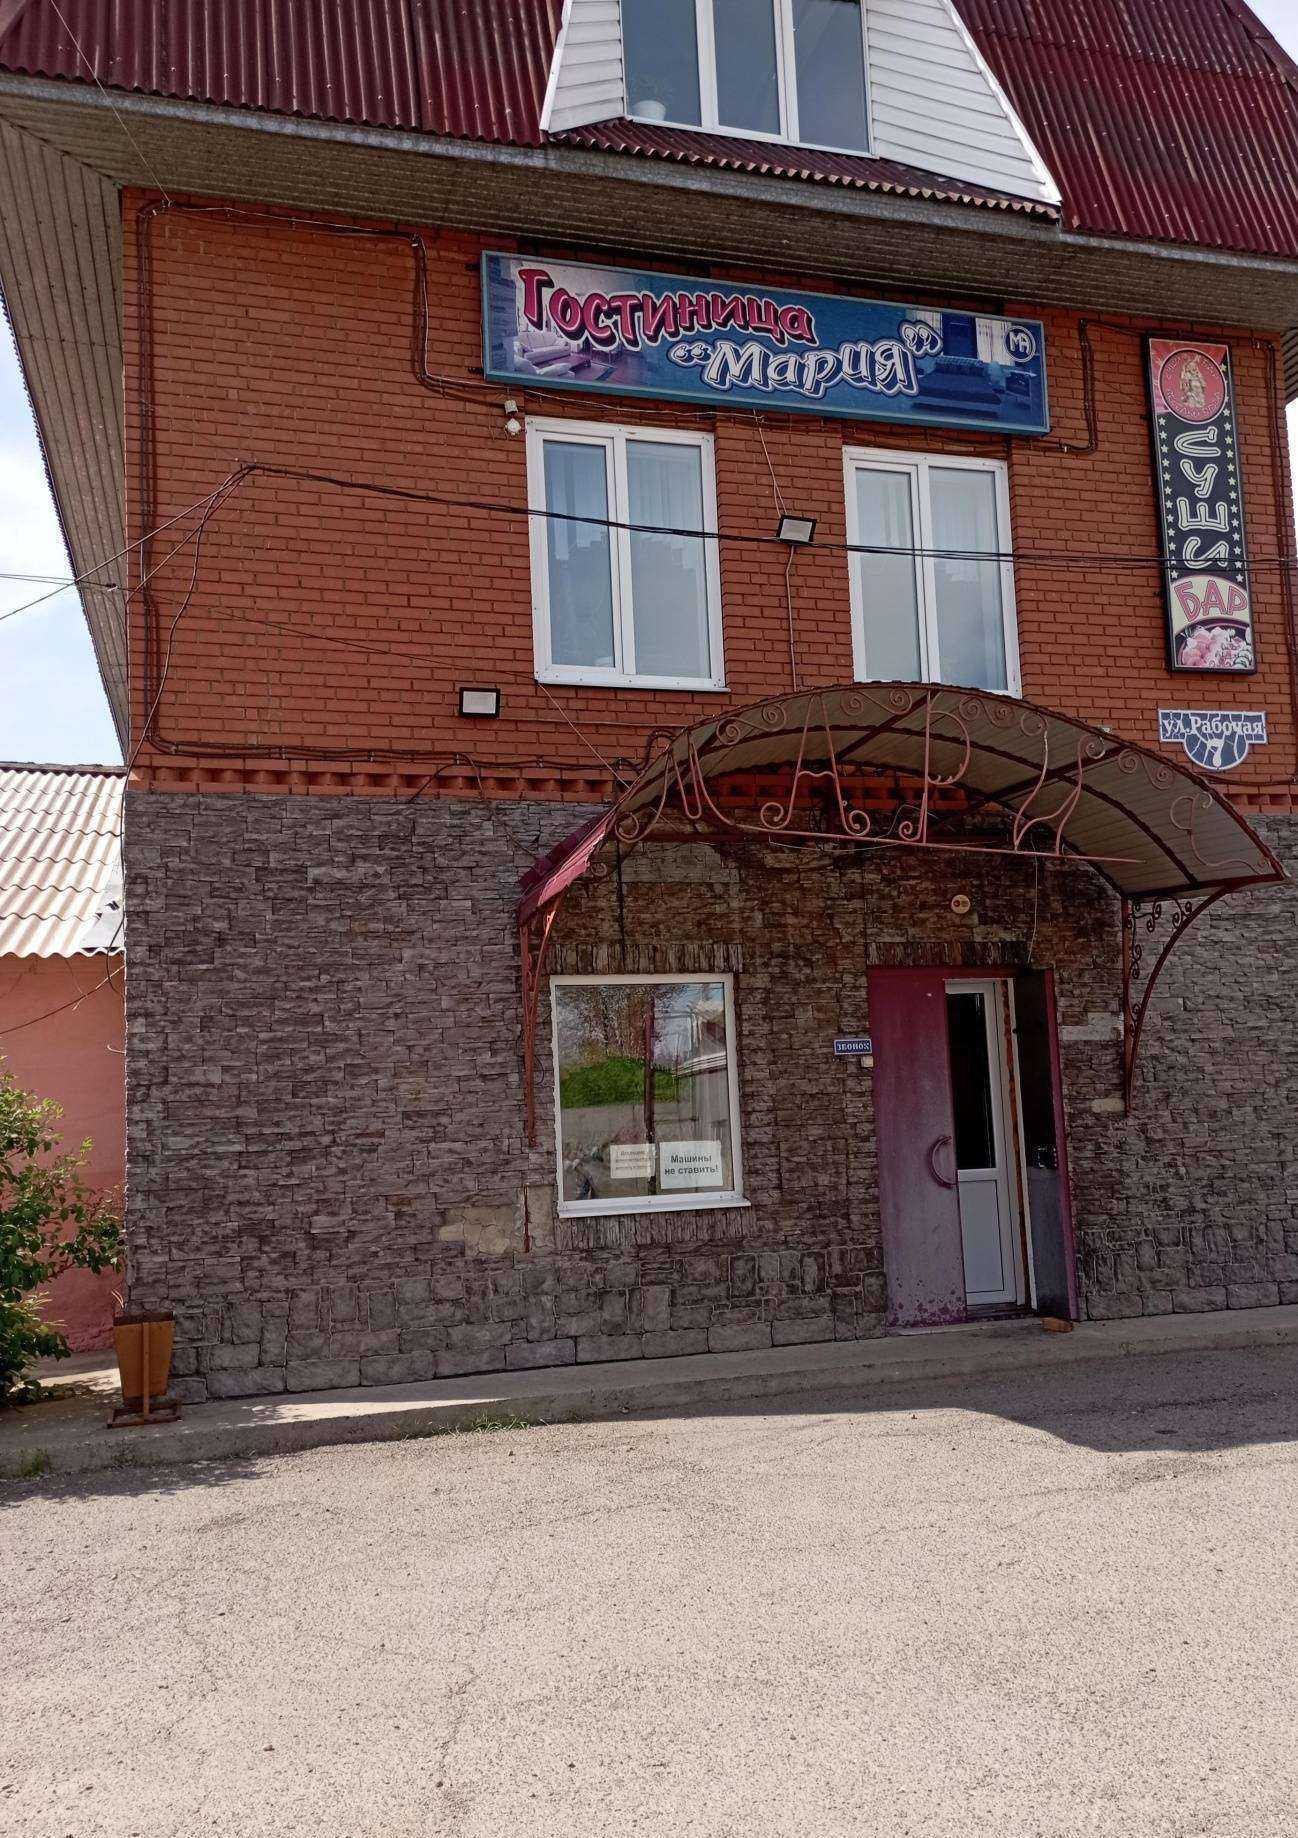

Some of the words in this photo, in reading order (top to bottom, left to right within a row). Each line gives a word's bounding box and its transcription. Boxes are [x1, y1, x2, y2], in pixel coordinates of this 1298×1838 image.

[518, 269, 819, 350] Гостиница
[1174, 579, 1248, 622] БАР
[1207, 738, 1225, 767] 7
[664, 1167, 676, 1176] не
[678, 1163, 719, 1175] ставить!
[670, 1154, 712, 1164] Машины
